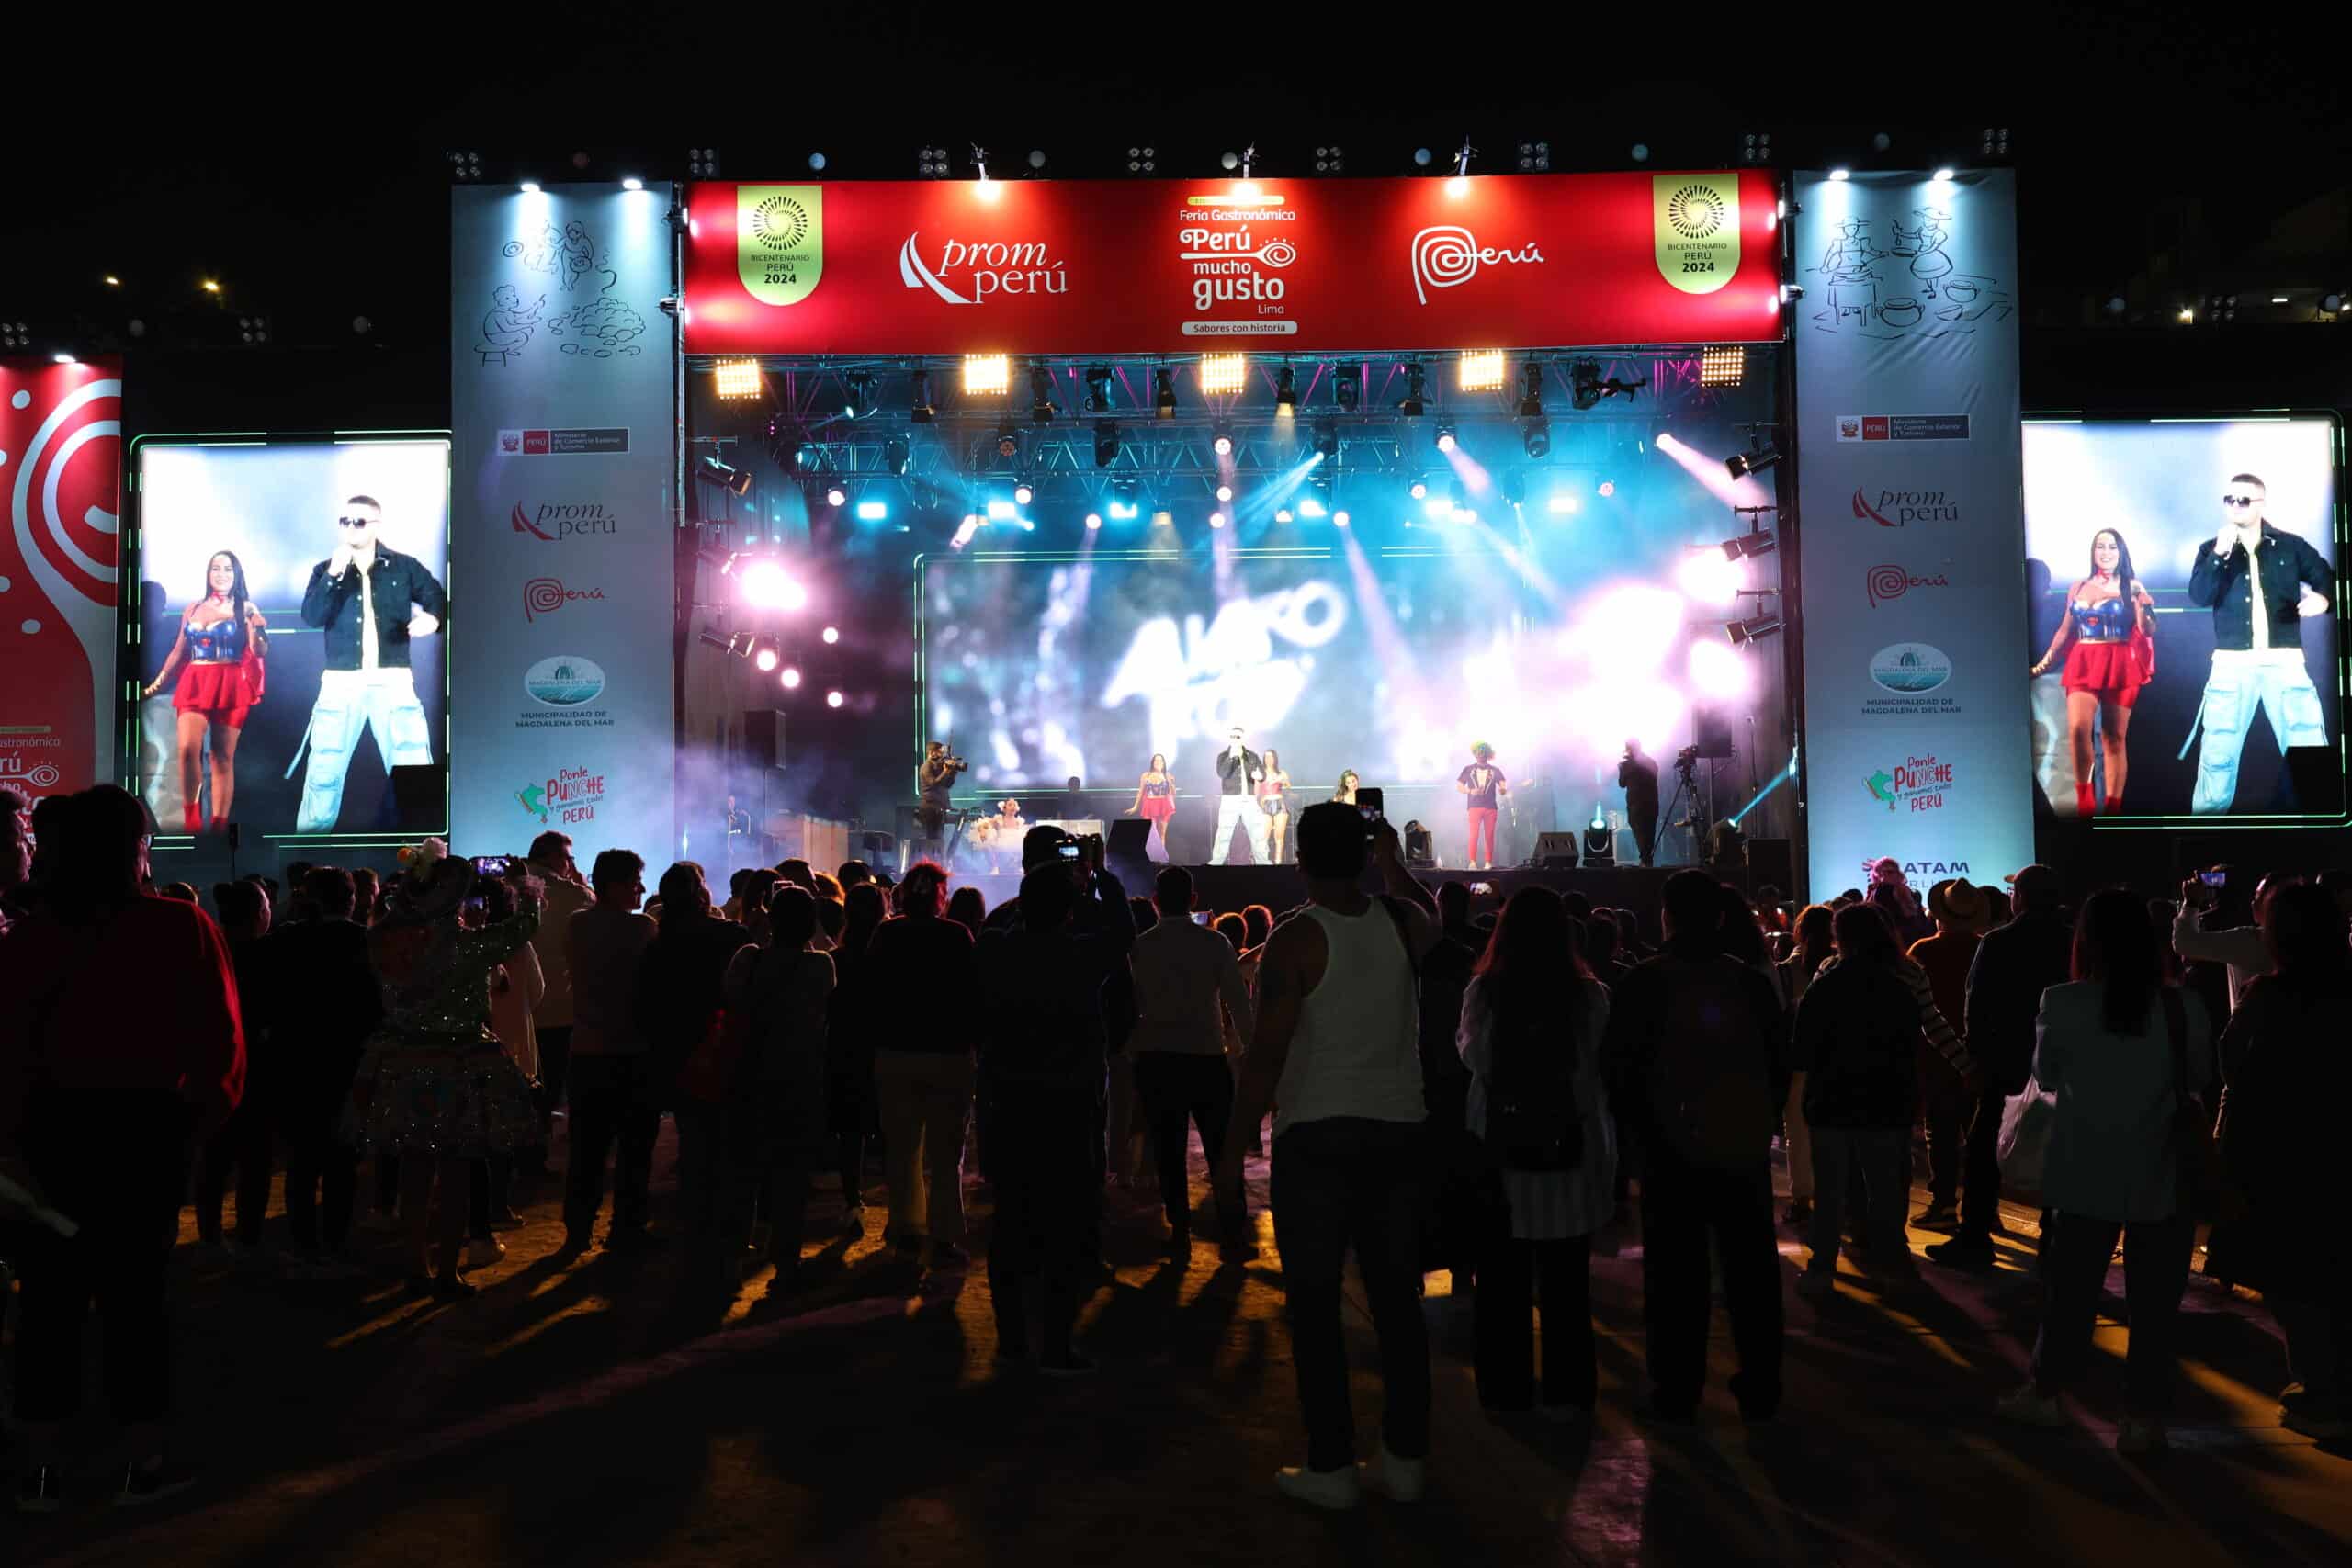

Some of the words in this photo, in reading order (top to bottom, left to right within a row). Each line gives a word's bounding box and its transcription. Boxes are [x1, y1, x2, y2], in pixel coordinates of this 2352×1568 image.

[1180, 210, 1208, 221] Feria
[1211, 209, 1295, 221] Gastronómica
[1180, 224, 1250, 250] Perú
[937, 237, 1047, 276] prom
[1684, 250, 1712, 260] PERÚ
[766, 262, 794, 271] PERÚ
[1194, 260, 1251, 274] mucho
[1683, 263, 1714, 272] 2024
[764, 274, 797, 284] 2024
[974, 261, 1068, 303] perú
[1193, 271, 1284, 310] gusto
[1258, 304, 1284, 314] Lima
[1193, 323, 1230, 333] Sabores
[1250, 322, 1285, 332] historia
[1876, 490, 1945, 512] prom
[536, 504, 604, 525] prom
[1899, 501, 1958, 527] perú
[559, 514, 616, 540] perú
[1908, 752, 1936, 770] Ponle
[560, 766, 588, 782] Ponle
[1912, 793, 1942, 812] PERÚ
[563, 805, 594, 825] PERÚ
[1904, 862, 1970, 874] ATAM
